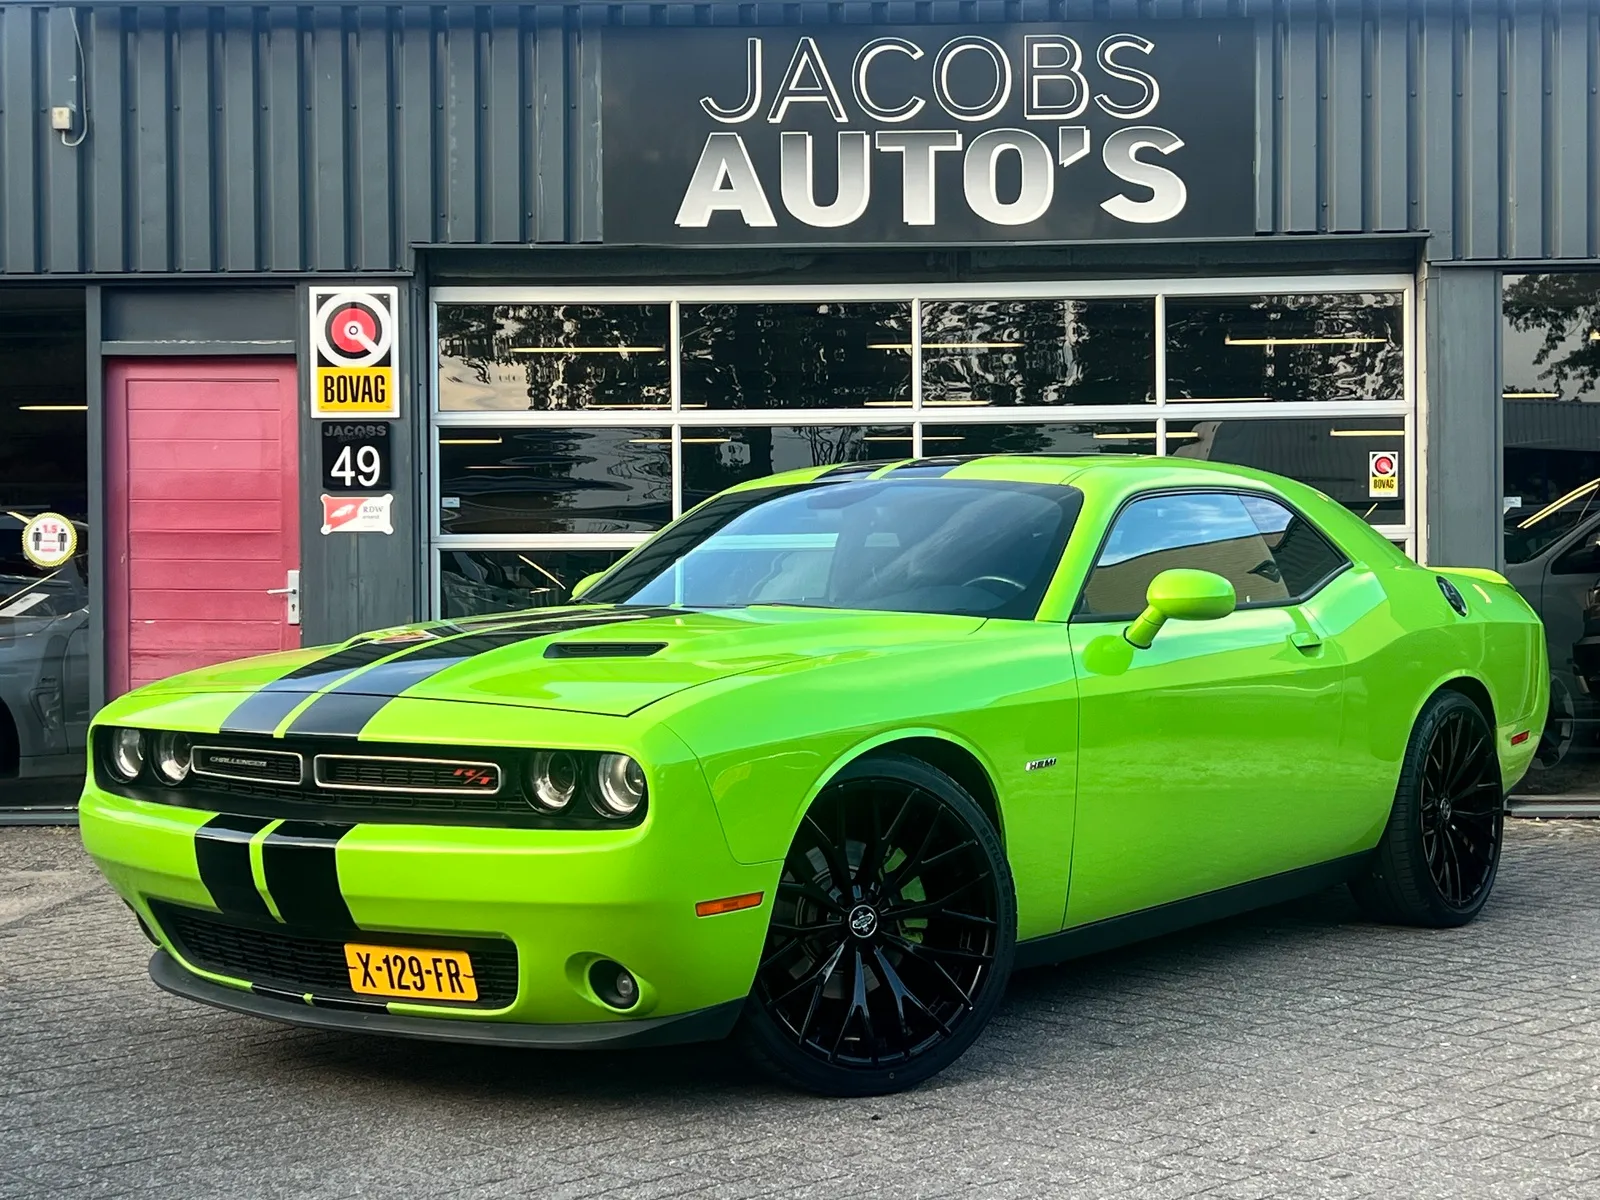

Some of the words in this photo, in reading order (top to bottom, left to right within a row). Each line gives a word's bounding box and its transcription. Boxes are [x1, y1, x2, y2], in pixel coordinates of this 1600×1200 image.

[699, 34, 1160, 124] JACOBS
[674, 126, 1188, 227] AUTO'S
[323, 374, 386, 404] BOVAG
[324, 425, 387, 437] JACOBS
[331, 445, 381, 487] 49
[1373, 479, 1394, 489] BOVAG
[209, 755, 268, 768] CHALLENGER
[453, 768, 497, 785] R/T
[355, 951, 465, 994] X-129-FR
